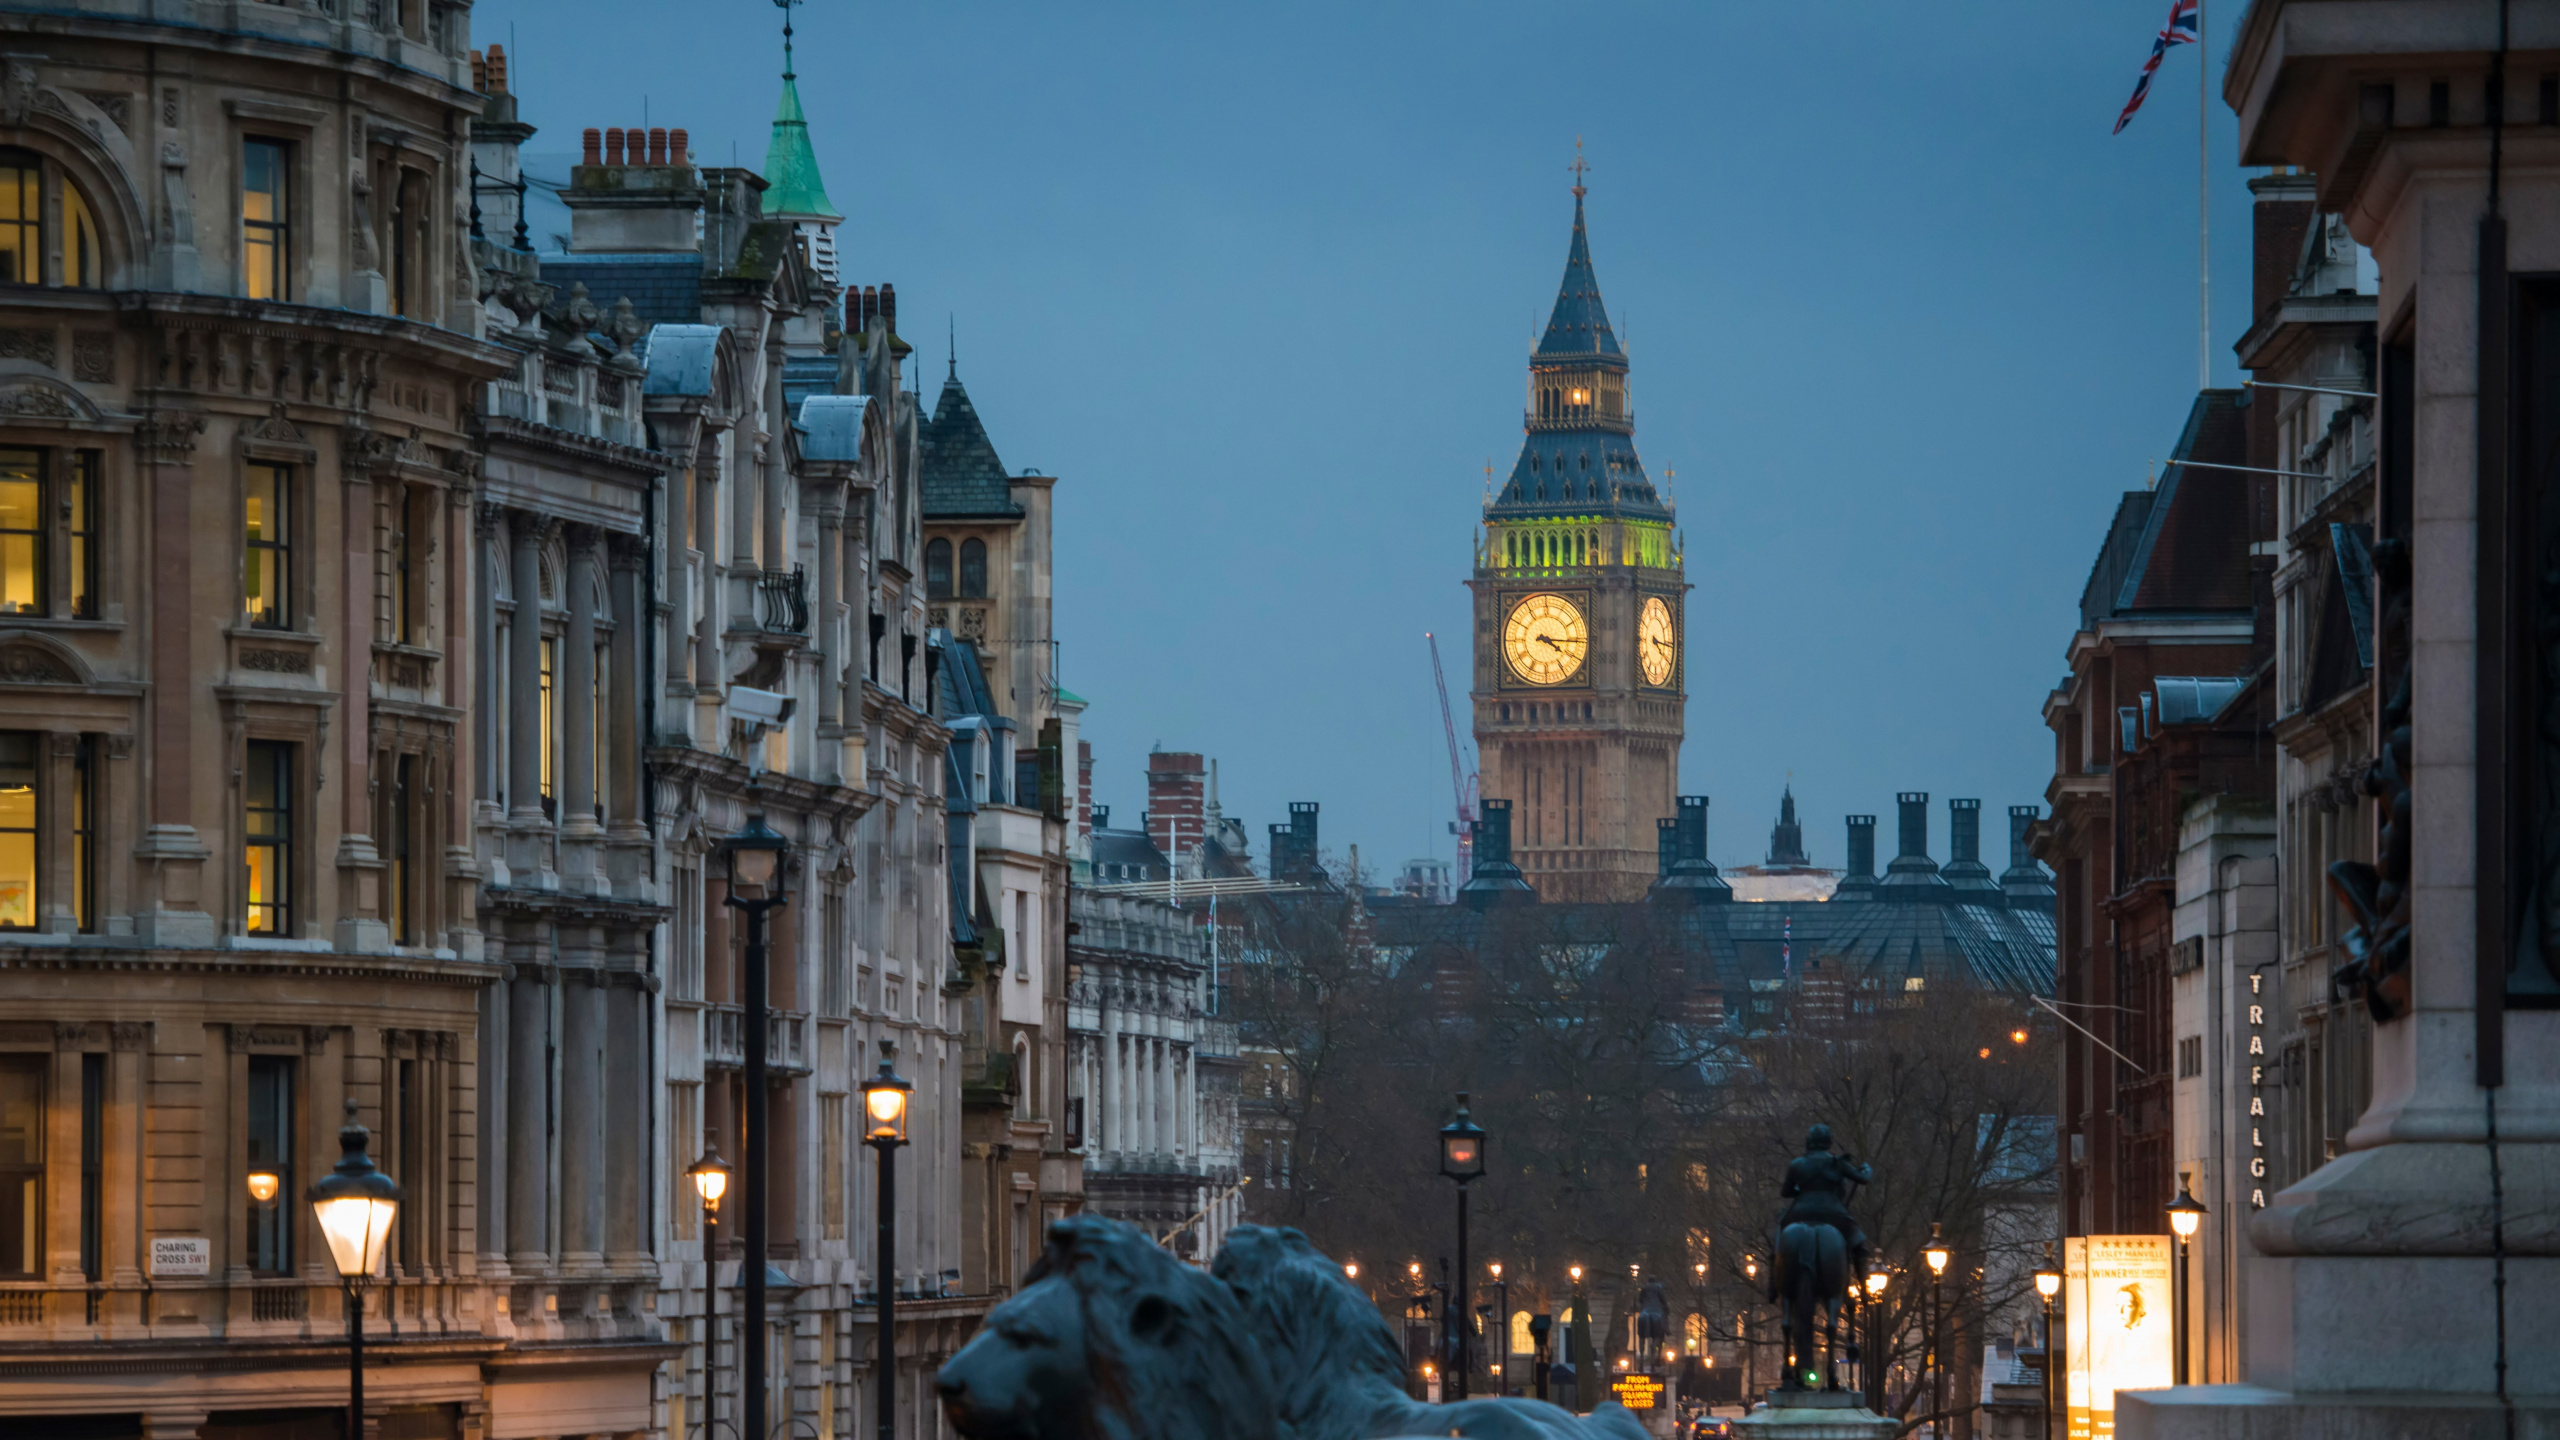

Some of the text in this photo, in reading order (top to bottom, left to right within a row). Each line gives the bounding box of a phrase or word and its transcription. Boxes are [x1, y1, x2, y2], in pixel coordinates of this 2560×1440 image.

[155, 1243, 197, 1253] CHARING
[2125, 1250, 2164, 1258] MANVILLE
[155, 1254, 206, 1264] CROSS SW1
[2092, 1268, 2128, 1279] WINNER
[1625, 1375, 1650, 1383] FROM
[1612, 1383, 1664, 1392] PARLIAMENT
[1622, 1400, 1654, 1408] CLOSED
